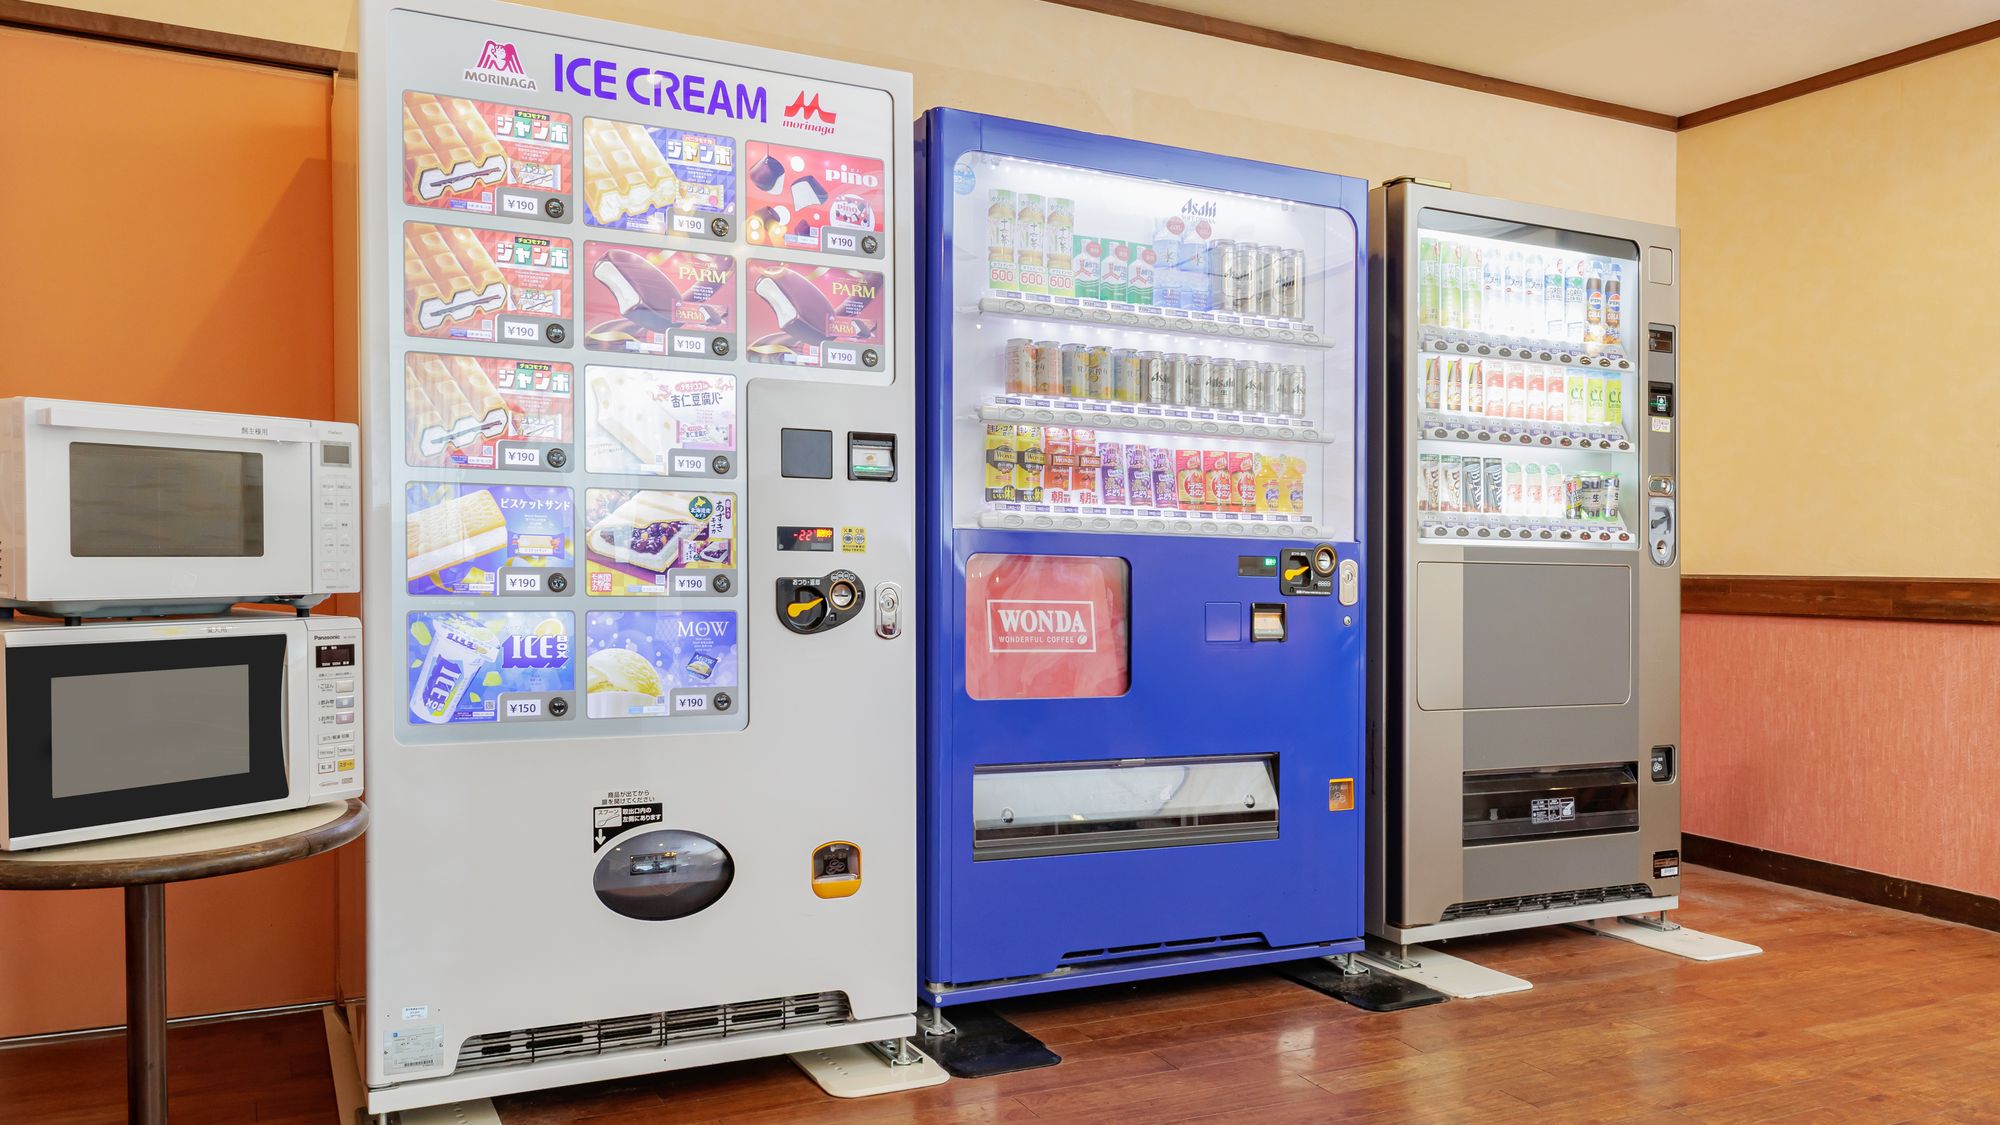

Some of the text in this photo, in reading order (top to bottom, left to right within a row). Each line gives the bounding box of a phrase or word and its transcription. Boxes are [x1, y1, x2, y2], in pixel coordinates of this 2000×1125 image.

[464, 70, 537, 91] MORINAGA
[554, 53, 767, 123] ICE CREAM
[497, 116, 569, 144] ジャンボ
[782, 119, 835, 135] morinaga
[667, 141, 731, 166] ジャンボ
[825, 164, 878, 188] pino
[508, 199, 534, 211] ¥190
[1181, 197, 1217, 218] Asahi
[831, 237, 853, 248] ¥190
[497, 243, 569, 269] ジャンボ
[680, 266, 726, 284] PARM
[991, 269, 1014, 281] 600
[1020, 272, 1043, 285] 600
[1049, 276, 1072, 289] 600
[832, 282, 876, 299] PARM
[507, 325, 534, 338] ¥190
[831, 351, 853, 362] ¥190
[499, 369, 570, 392] ジャンボ
[671, 392, 723, 408] 杏仁豆腐バー
[508, 451, 535, 462] ¥190
[501, 497, 571, 512] ビスケットサンド
[1051, 491, 1064, 503] 朝
[1080, 492, 1092, 504] 朝
[509, 577, 536, 588] ¥190
[679, 579, 703, 588] ¥190
[997, 609, 1087, 633] WONDA
[677, 621, 729, 637] MOW
[998, 635, 1075, 643] WONDERFUL COFFEE
[511, 635, 553, 659] ICE
[556, 635, 568, 659] BOX
[509, 703, 537, 714] ¥150
[679, 698, 703, 708] ¥190
